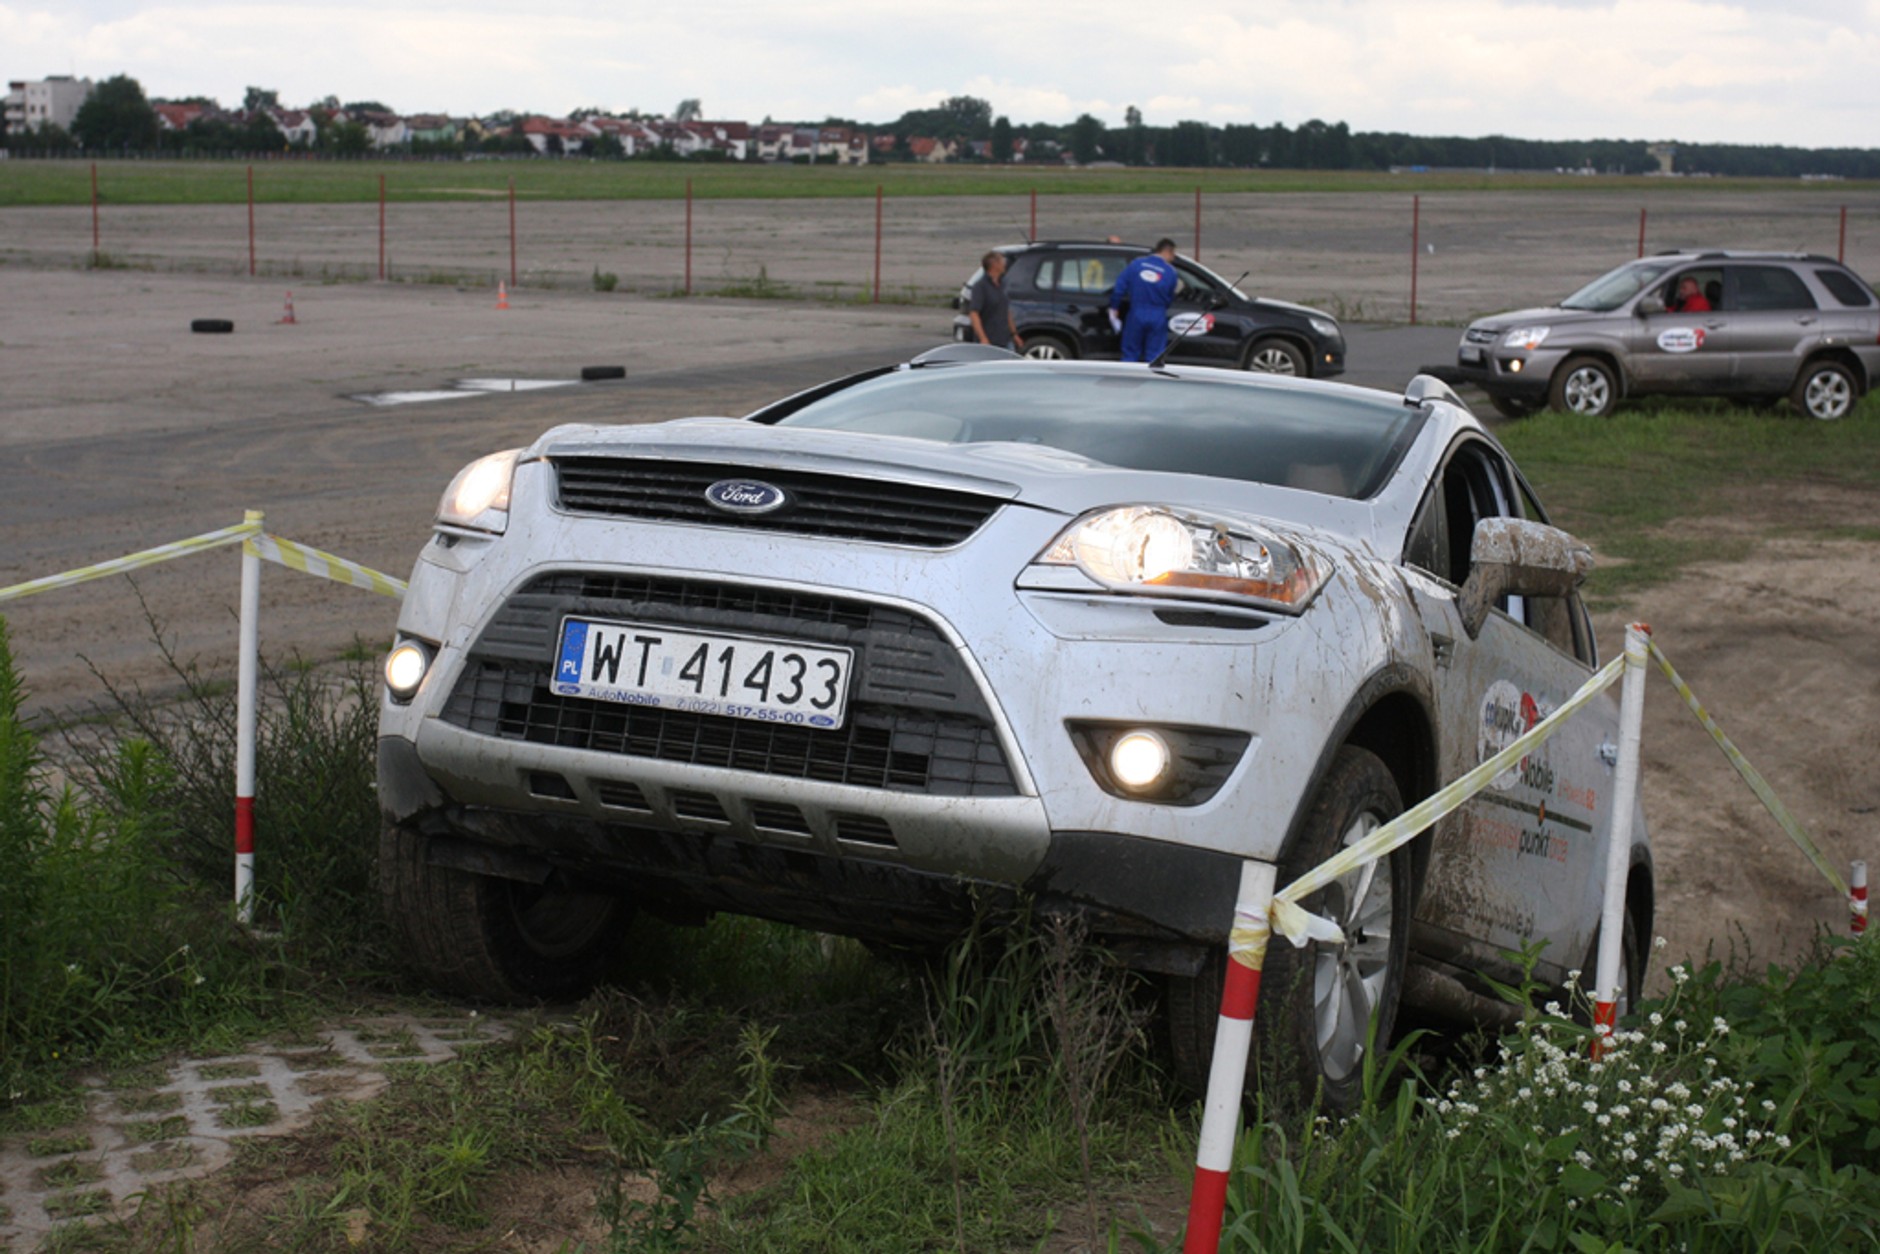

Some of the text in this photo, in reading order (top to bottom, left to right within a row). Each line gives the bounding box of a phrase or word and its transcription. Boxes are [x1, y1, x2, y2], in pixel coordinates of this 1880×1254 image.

[721, 484, 765, 504] Ford
[562, 660, 578, 675] PL
[591, 631, 841, 710] WT 41433
[726, 704, 805, 725] 517-55-00
